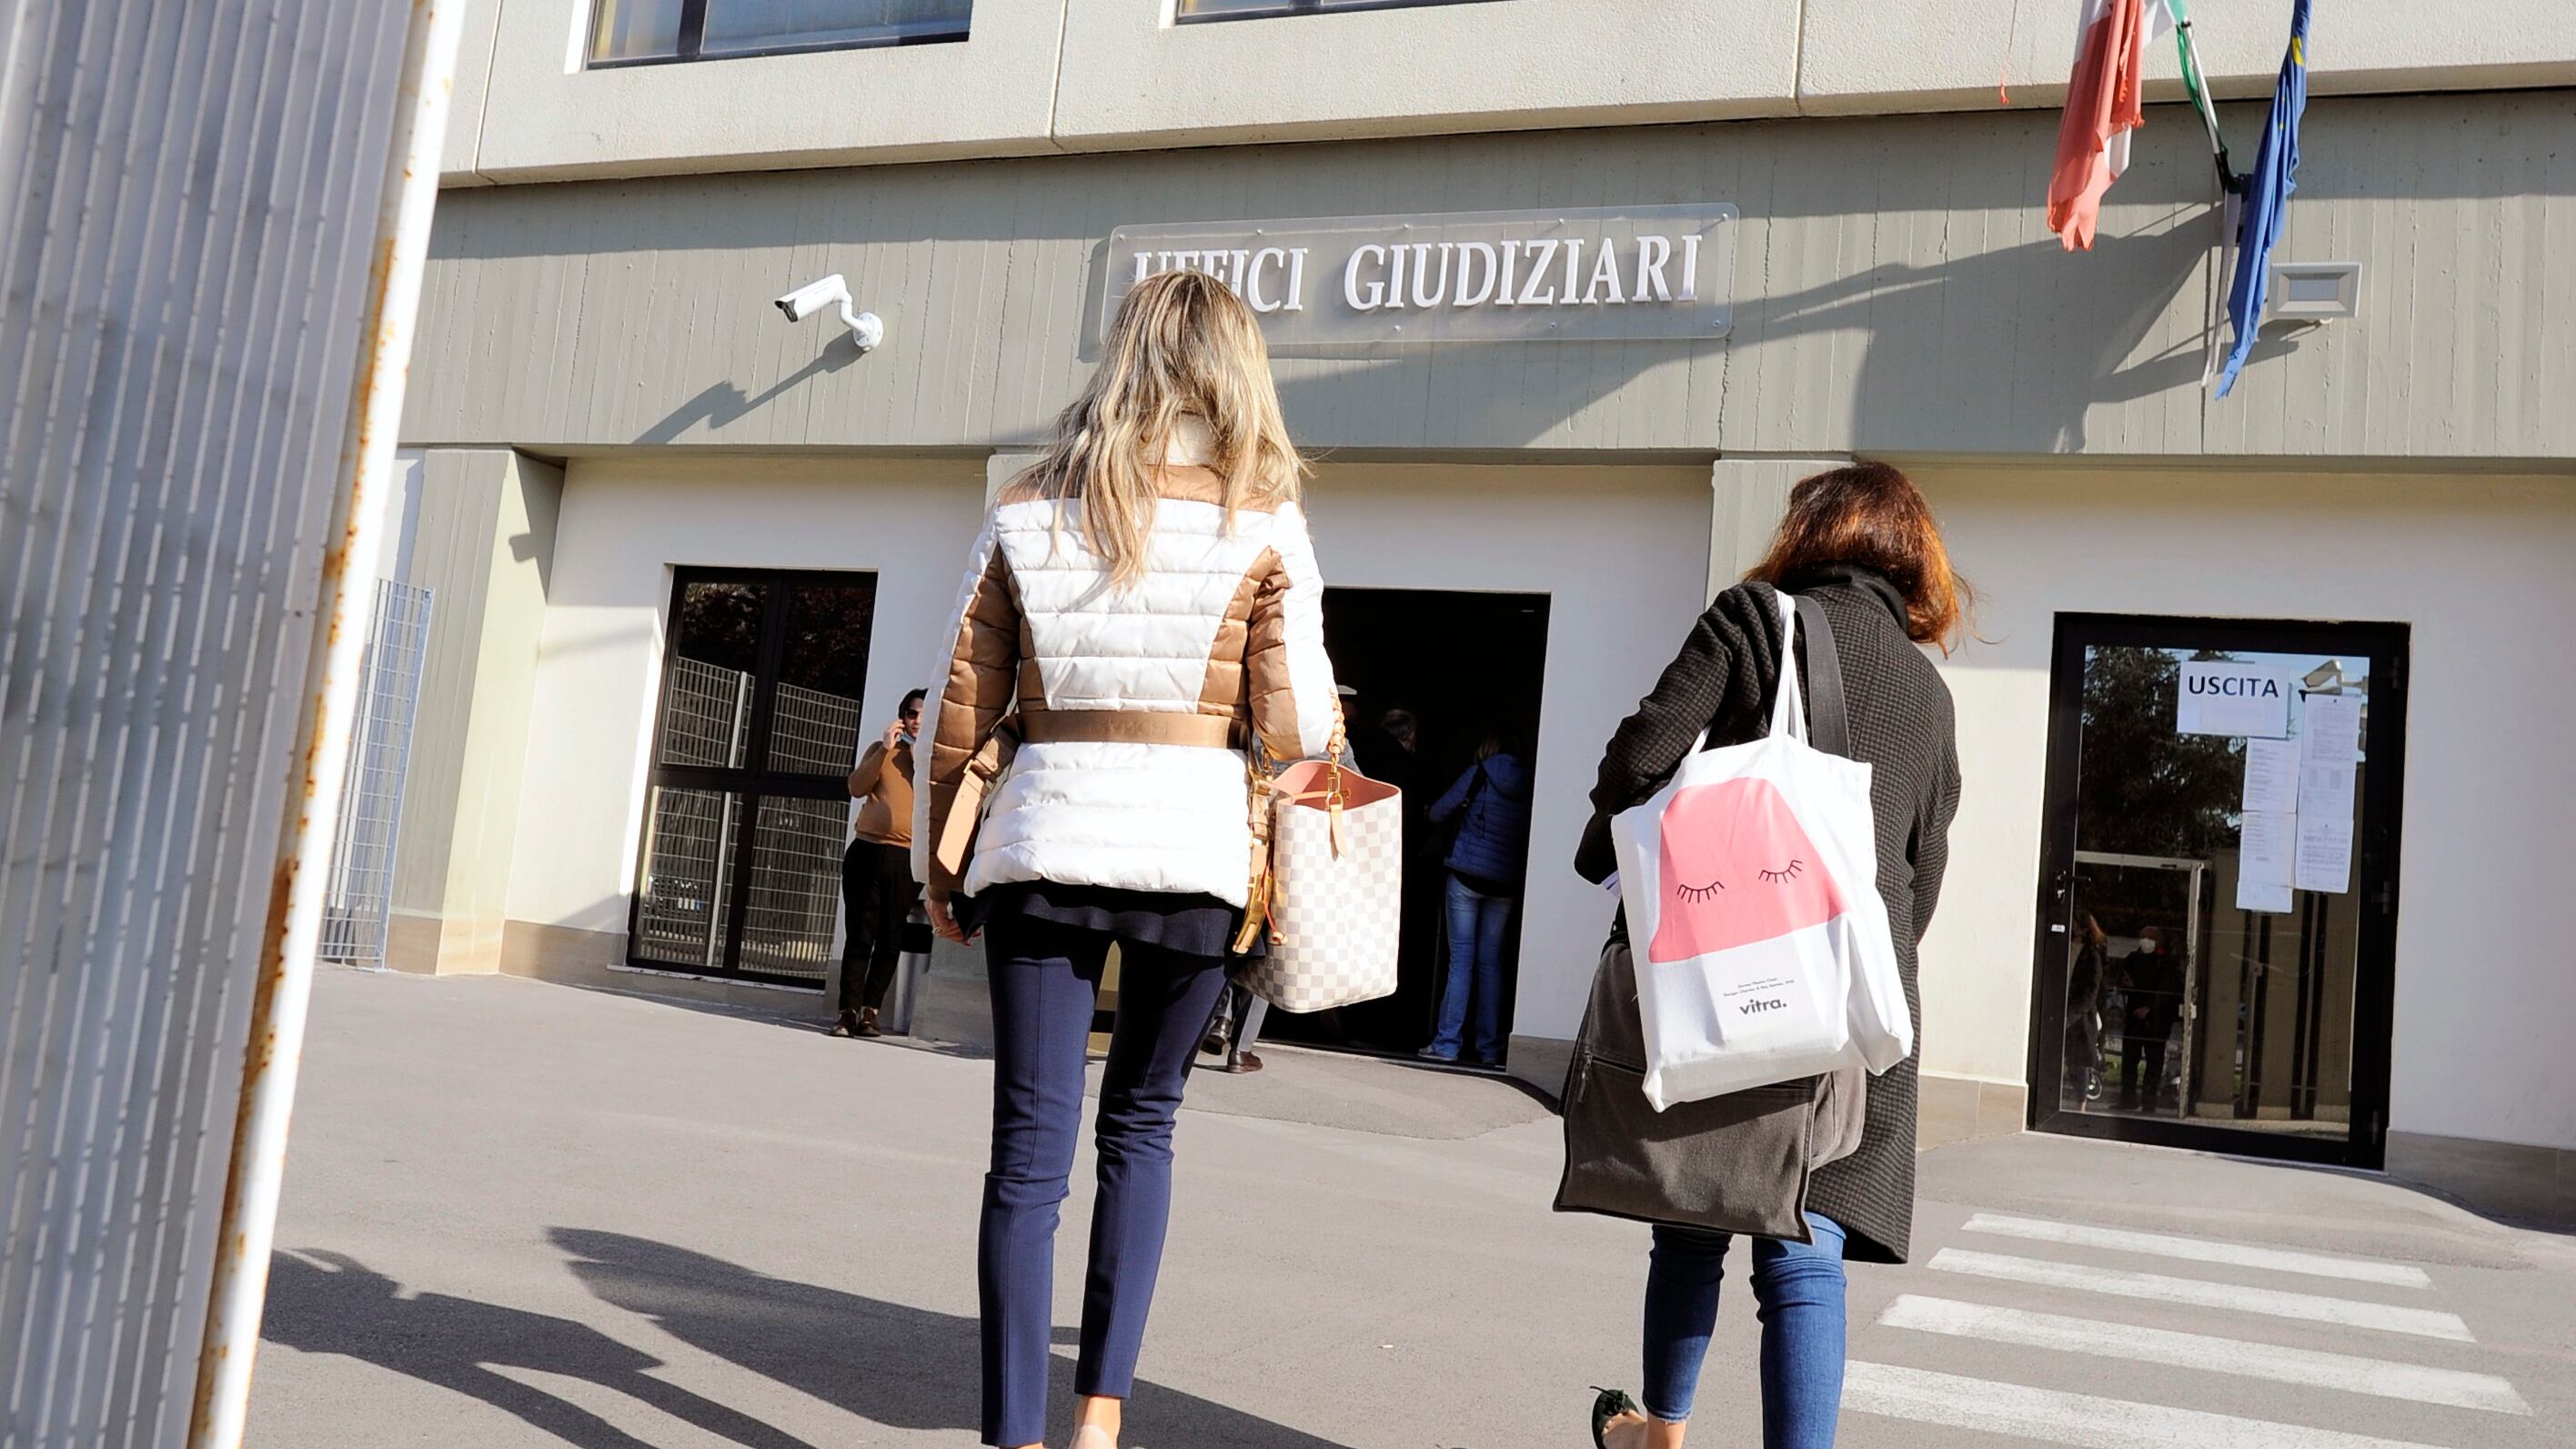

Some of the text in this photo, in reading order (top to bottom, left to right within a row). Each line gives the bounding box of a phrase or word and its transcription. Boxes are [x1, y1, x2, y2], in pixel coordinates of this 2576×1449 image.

[1343, 234, 1704, 310] GIUDIZIARI
[2189, 676, 2279, 698] USCITA
[1739, 999, 1787, 1014] vitra.
